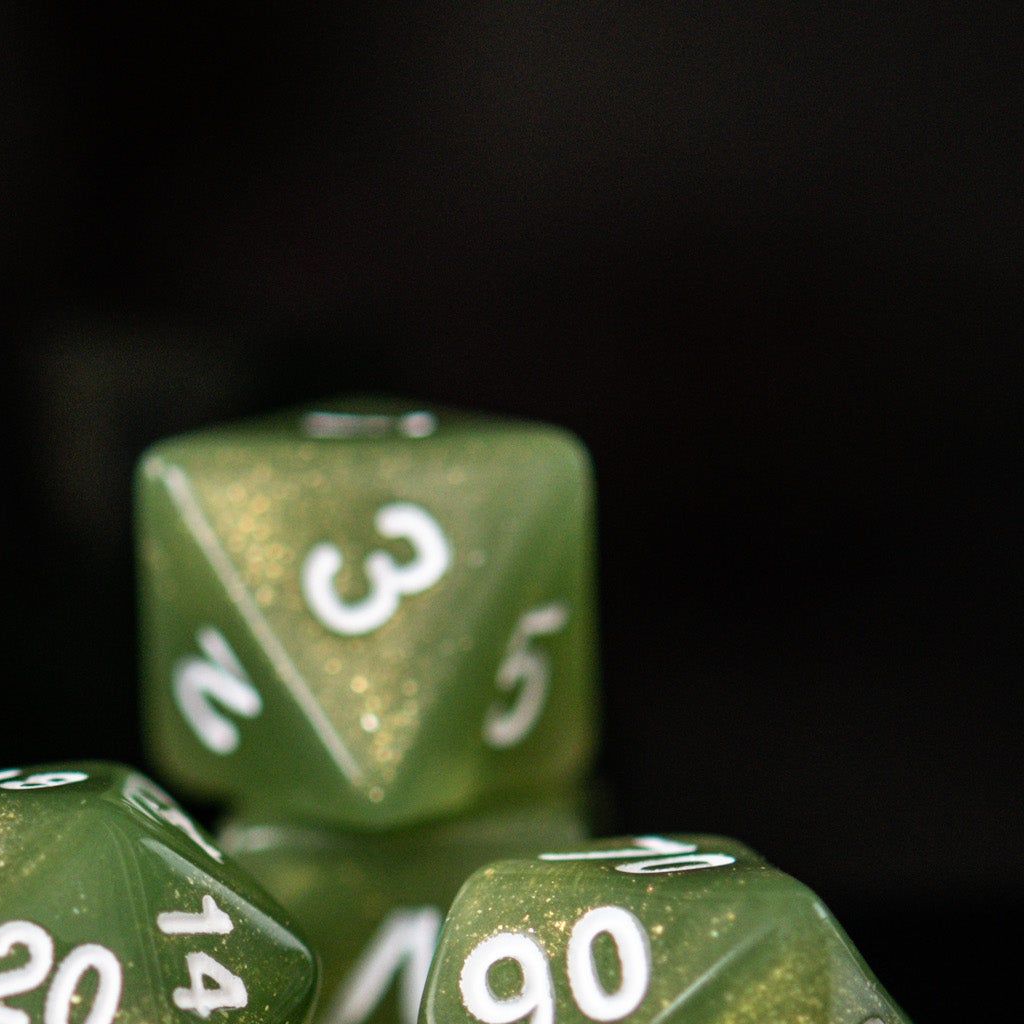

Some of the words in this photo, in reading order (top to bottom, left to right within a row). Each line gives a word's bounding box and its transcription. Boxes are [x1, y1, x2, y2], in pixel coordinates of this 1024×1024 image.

[301, 503, 452, 636] 3
[483, 602, 568, 748] 5
[156, 894, 250, 1019] 14
